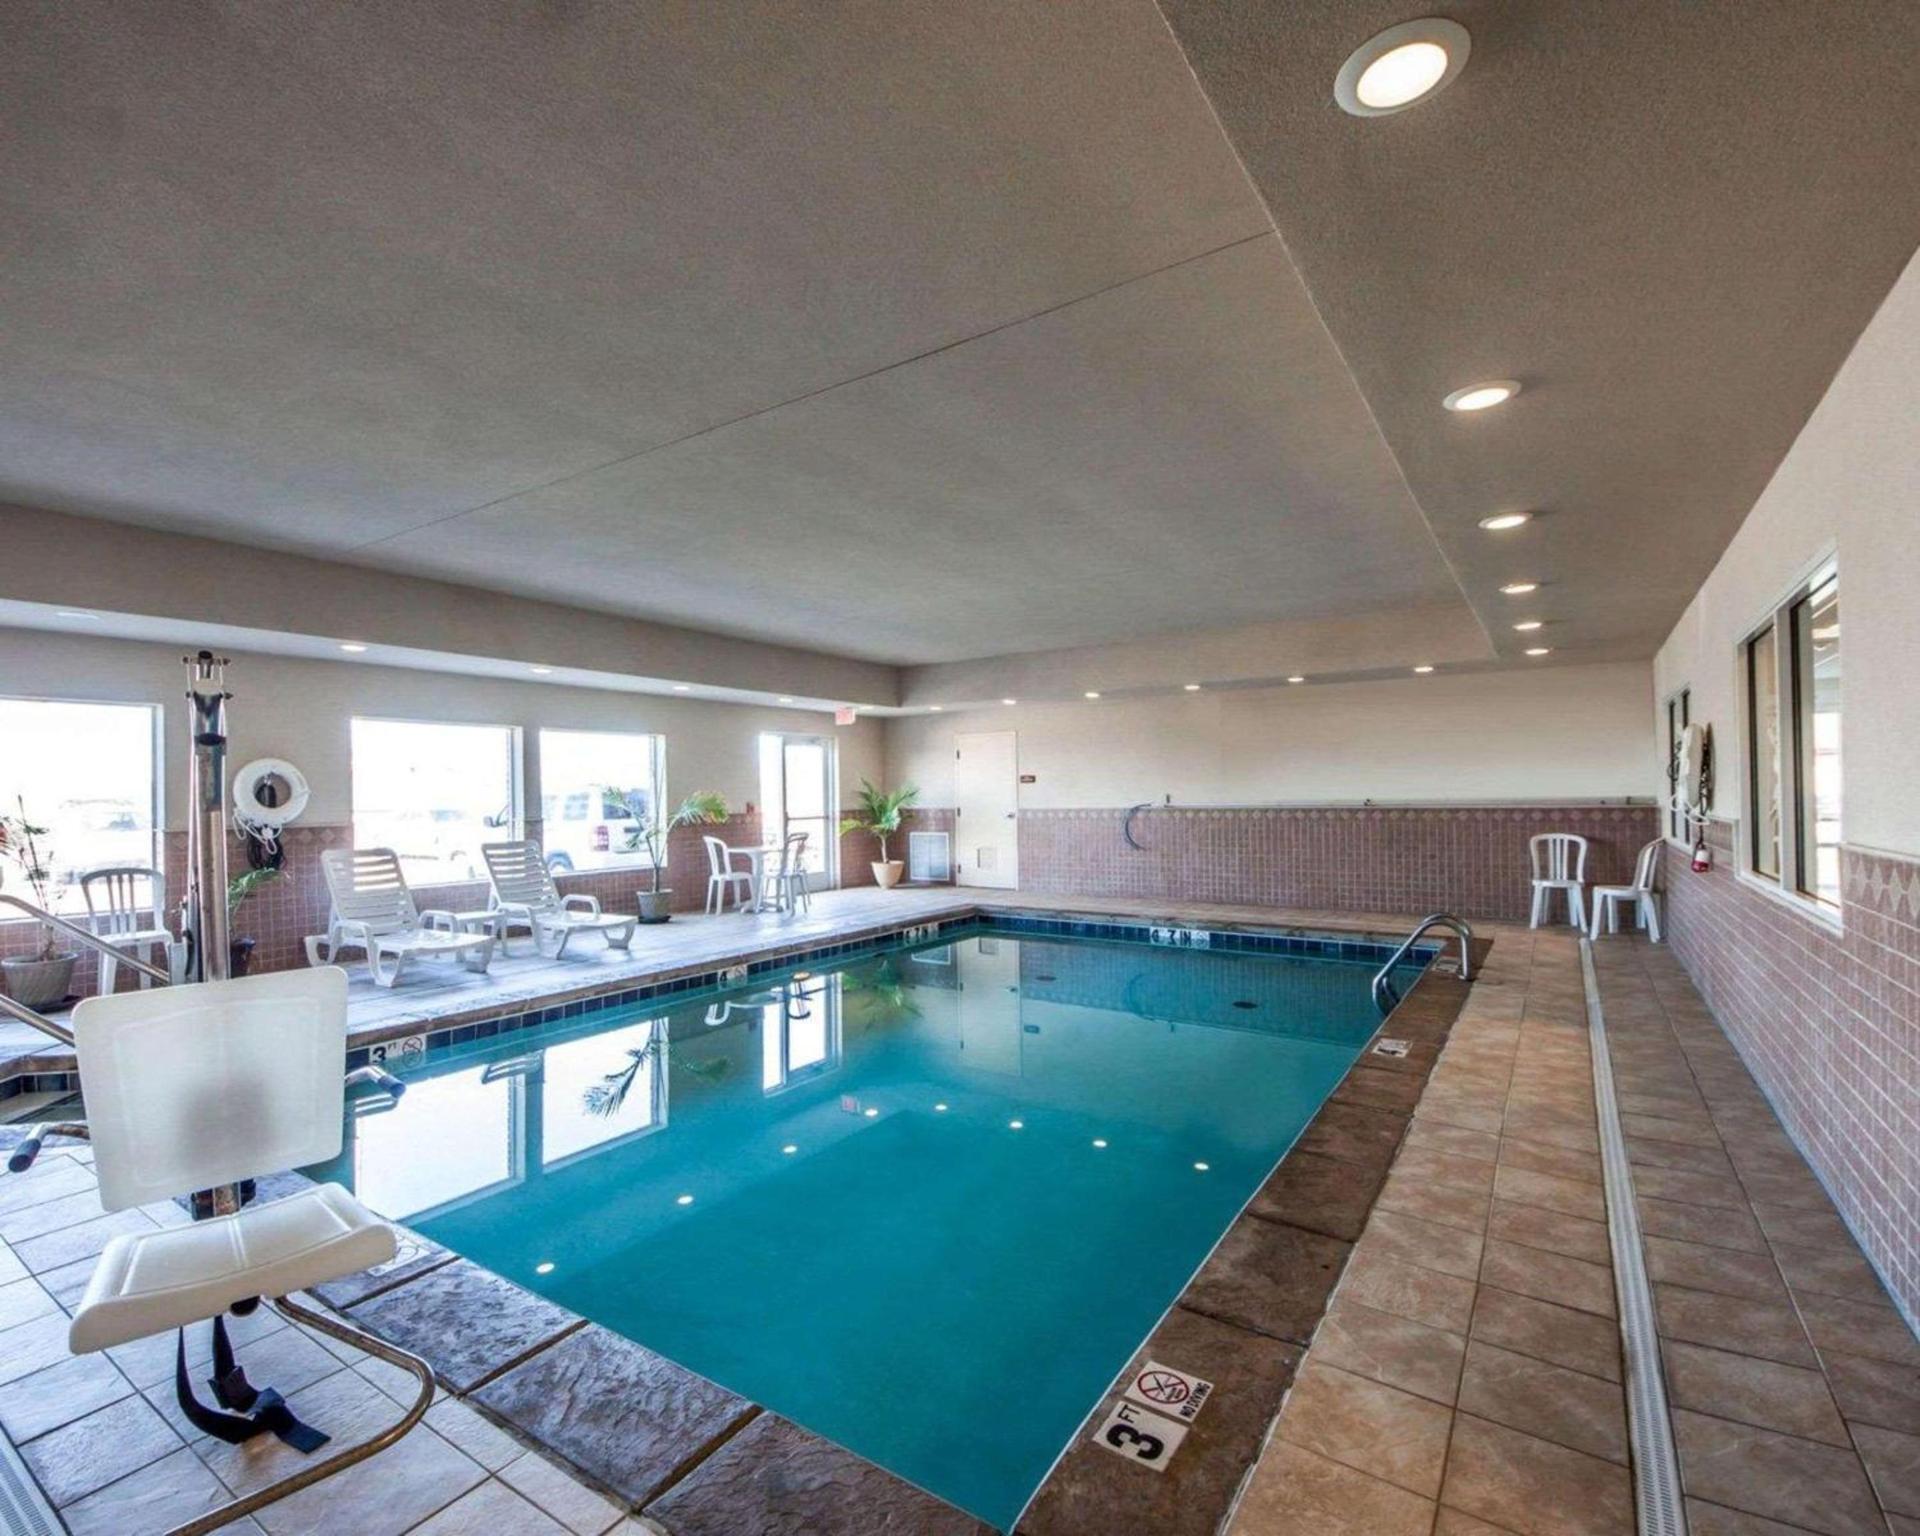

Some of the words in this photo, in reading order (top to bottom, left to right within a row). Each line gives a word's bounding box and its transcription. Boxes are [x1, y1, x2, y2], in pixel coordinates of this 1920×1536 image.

[373, 1046, 386, 1062] 3
[1186, 1381, 1210, 1409] DIVING
[1117, 1404, 1141, 1424] FT
[1179, 1404, 1196, 1419] NO
[1106, 1423, 1164, 1461] 3
